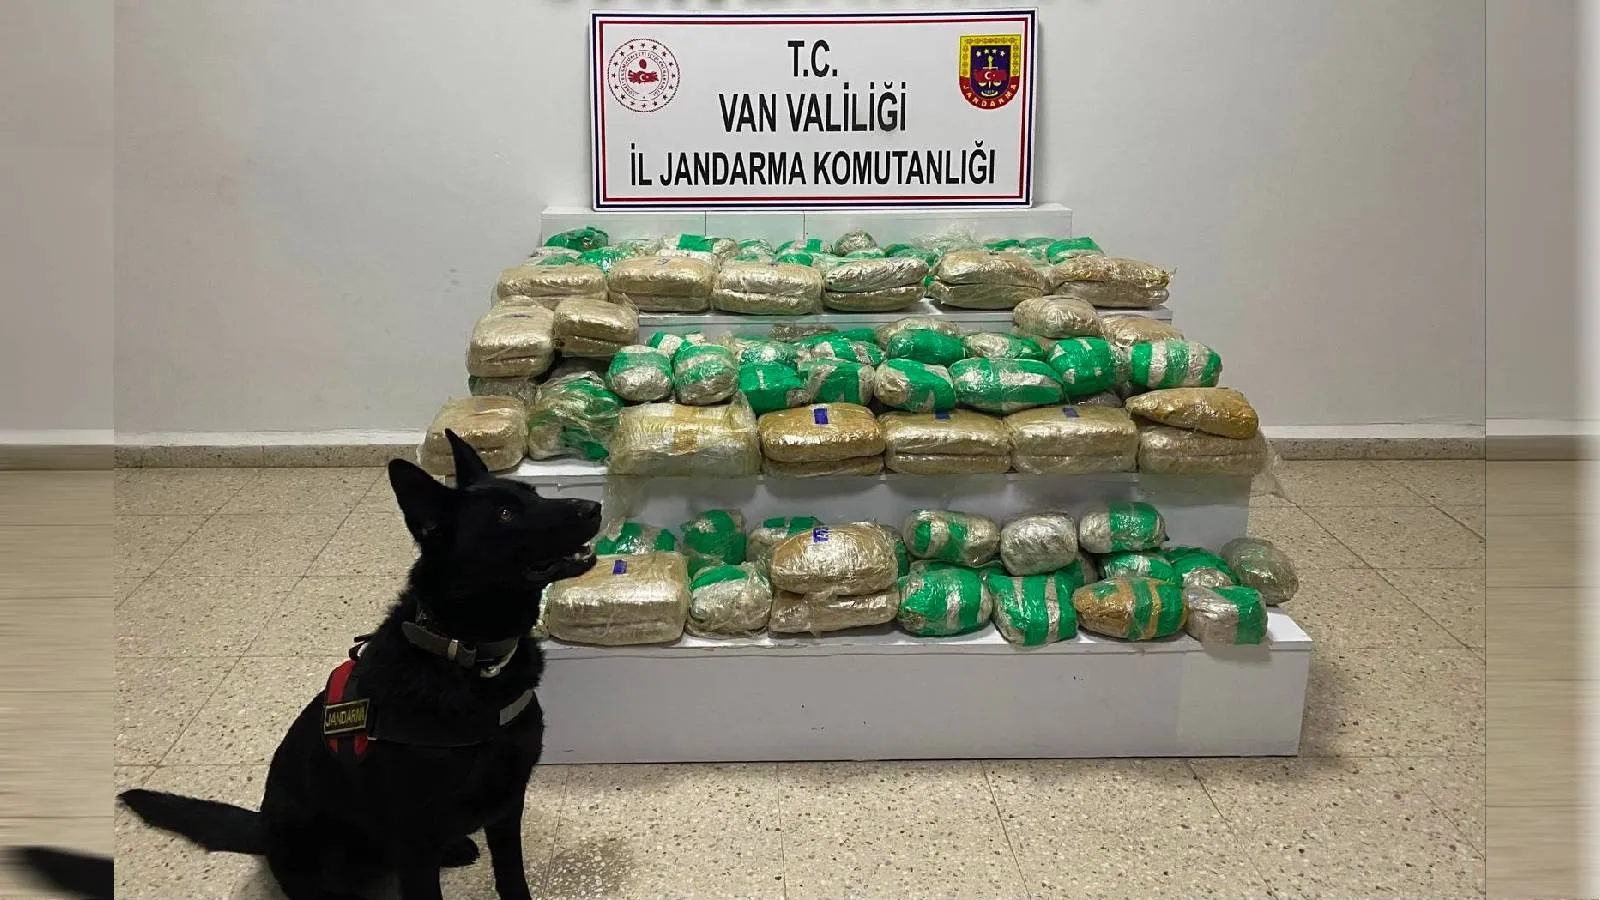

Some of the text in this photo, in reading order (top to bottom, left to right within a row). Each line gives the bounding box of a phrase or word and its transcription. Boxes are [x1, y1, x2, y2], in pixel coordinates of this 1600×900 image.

[788, 40, 837, 77] T.C.
[719, 81, 905, 132] VAN VALİLİĞİ
[964, 84, 1016, 106] JANDARMA
[630, 141, 995, 186] İL JANDARMA KOMUTANLIĞI
